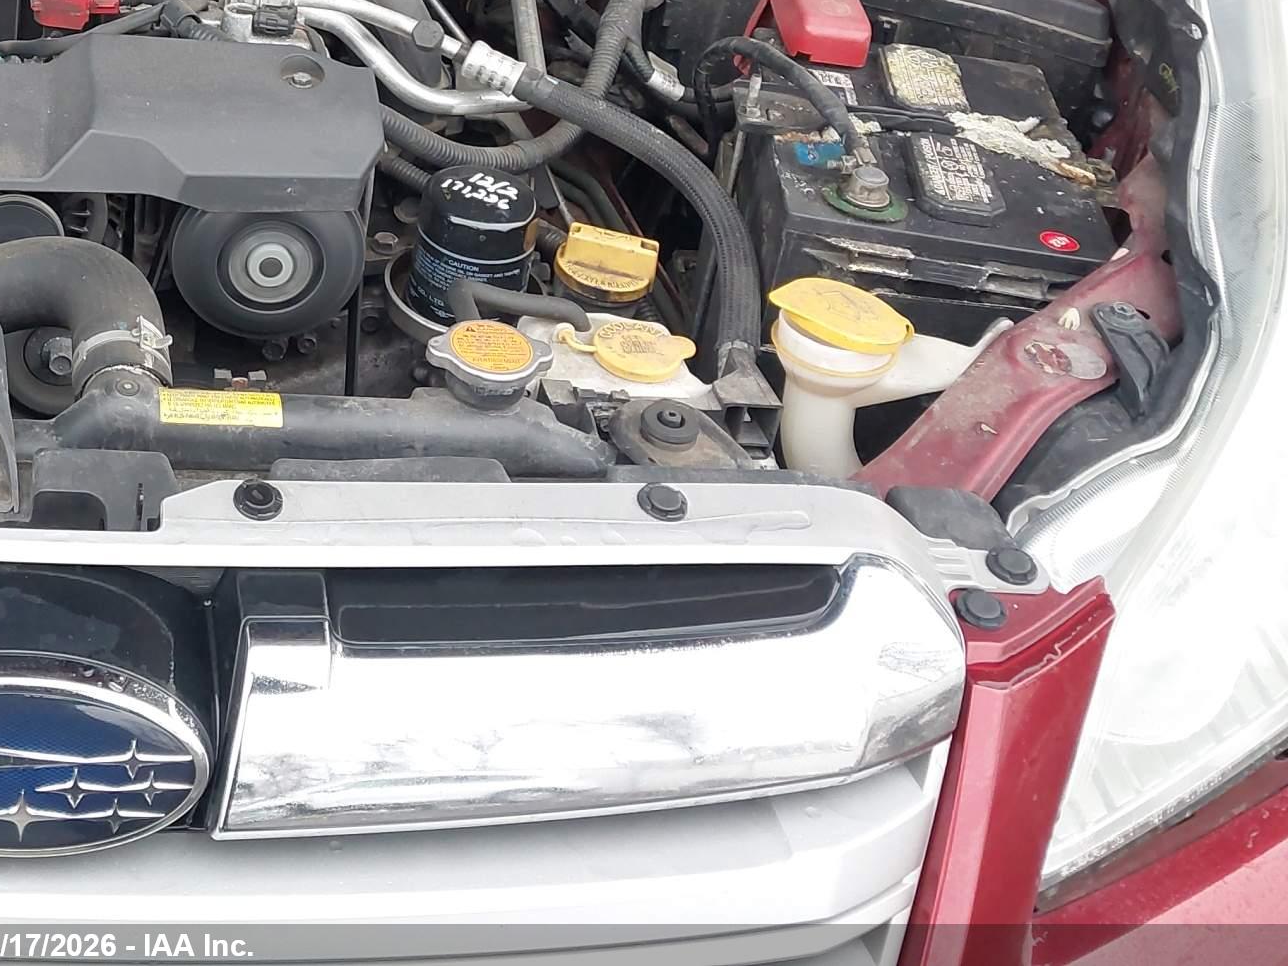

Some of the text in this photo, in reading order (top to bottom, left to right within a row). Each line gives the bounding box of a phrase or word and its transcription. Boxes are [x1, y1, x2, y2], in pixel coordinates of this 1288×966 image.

[468, 173, 518, 200] 12/2
[448, 259, 480, 273] CAUTION
[598, 322, 666, 338] COOLANT
